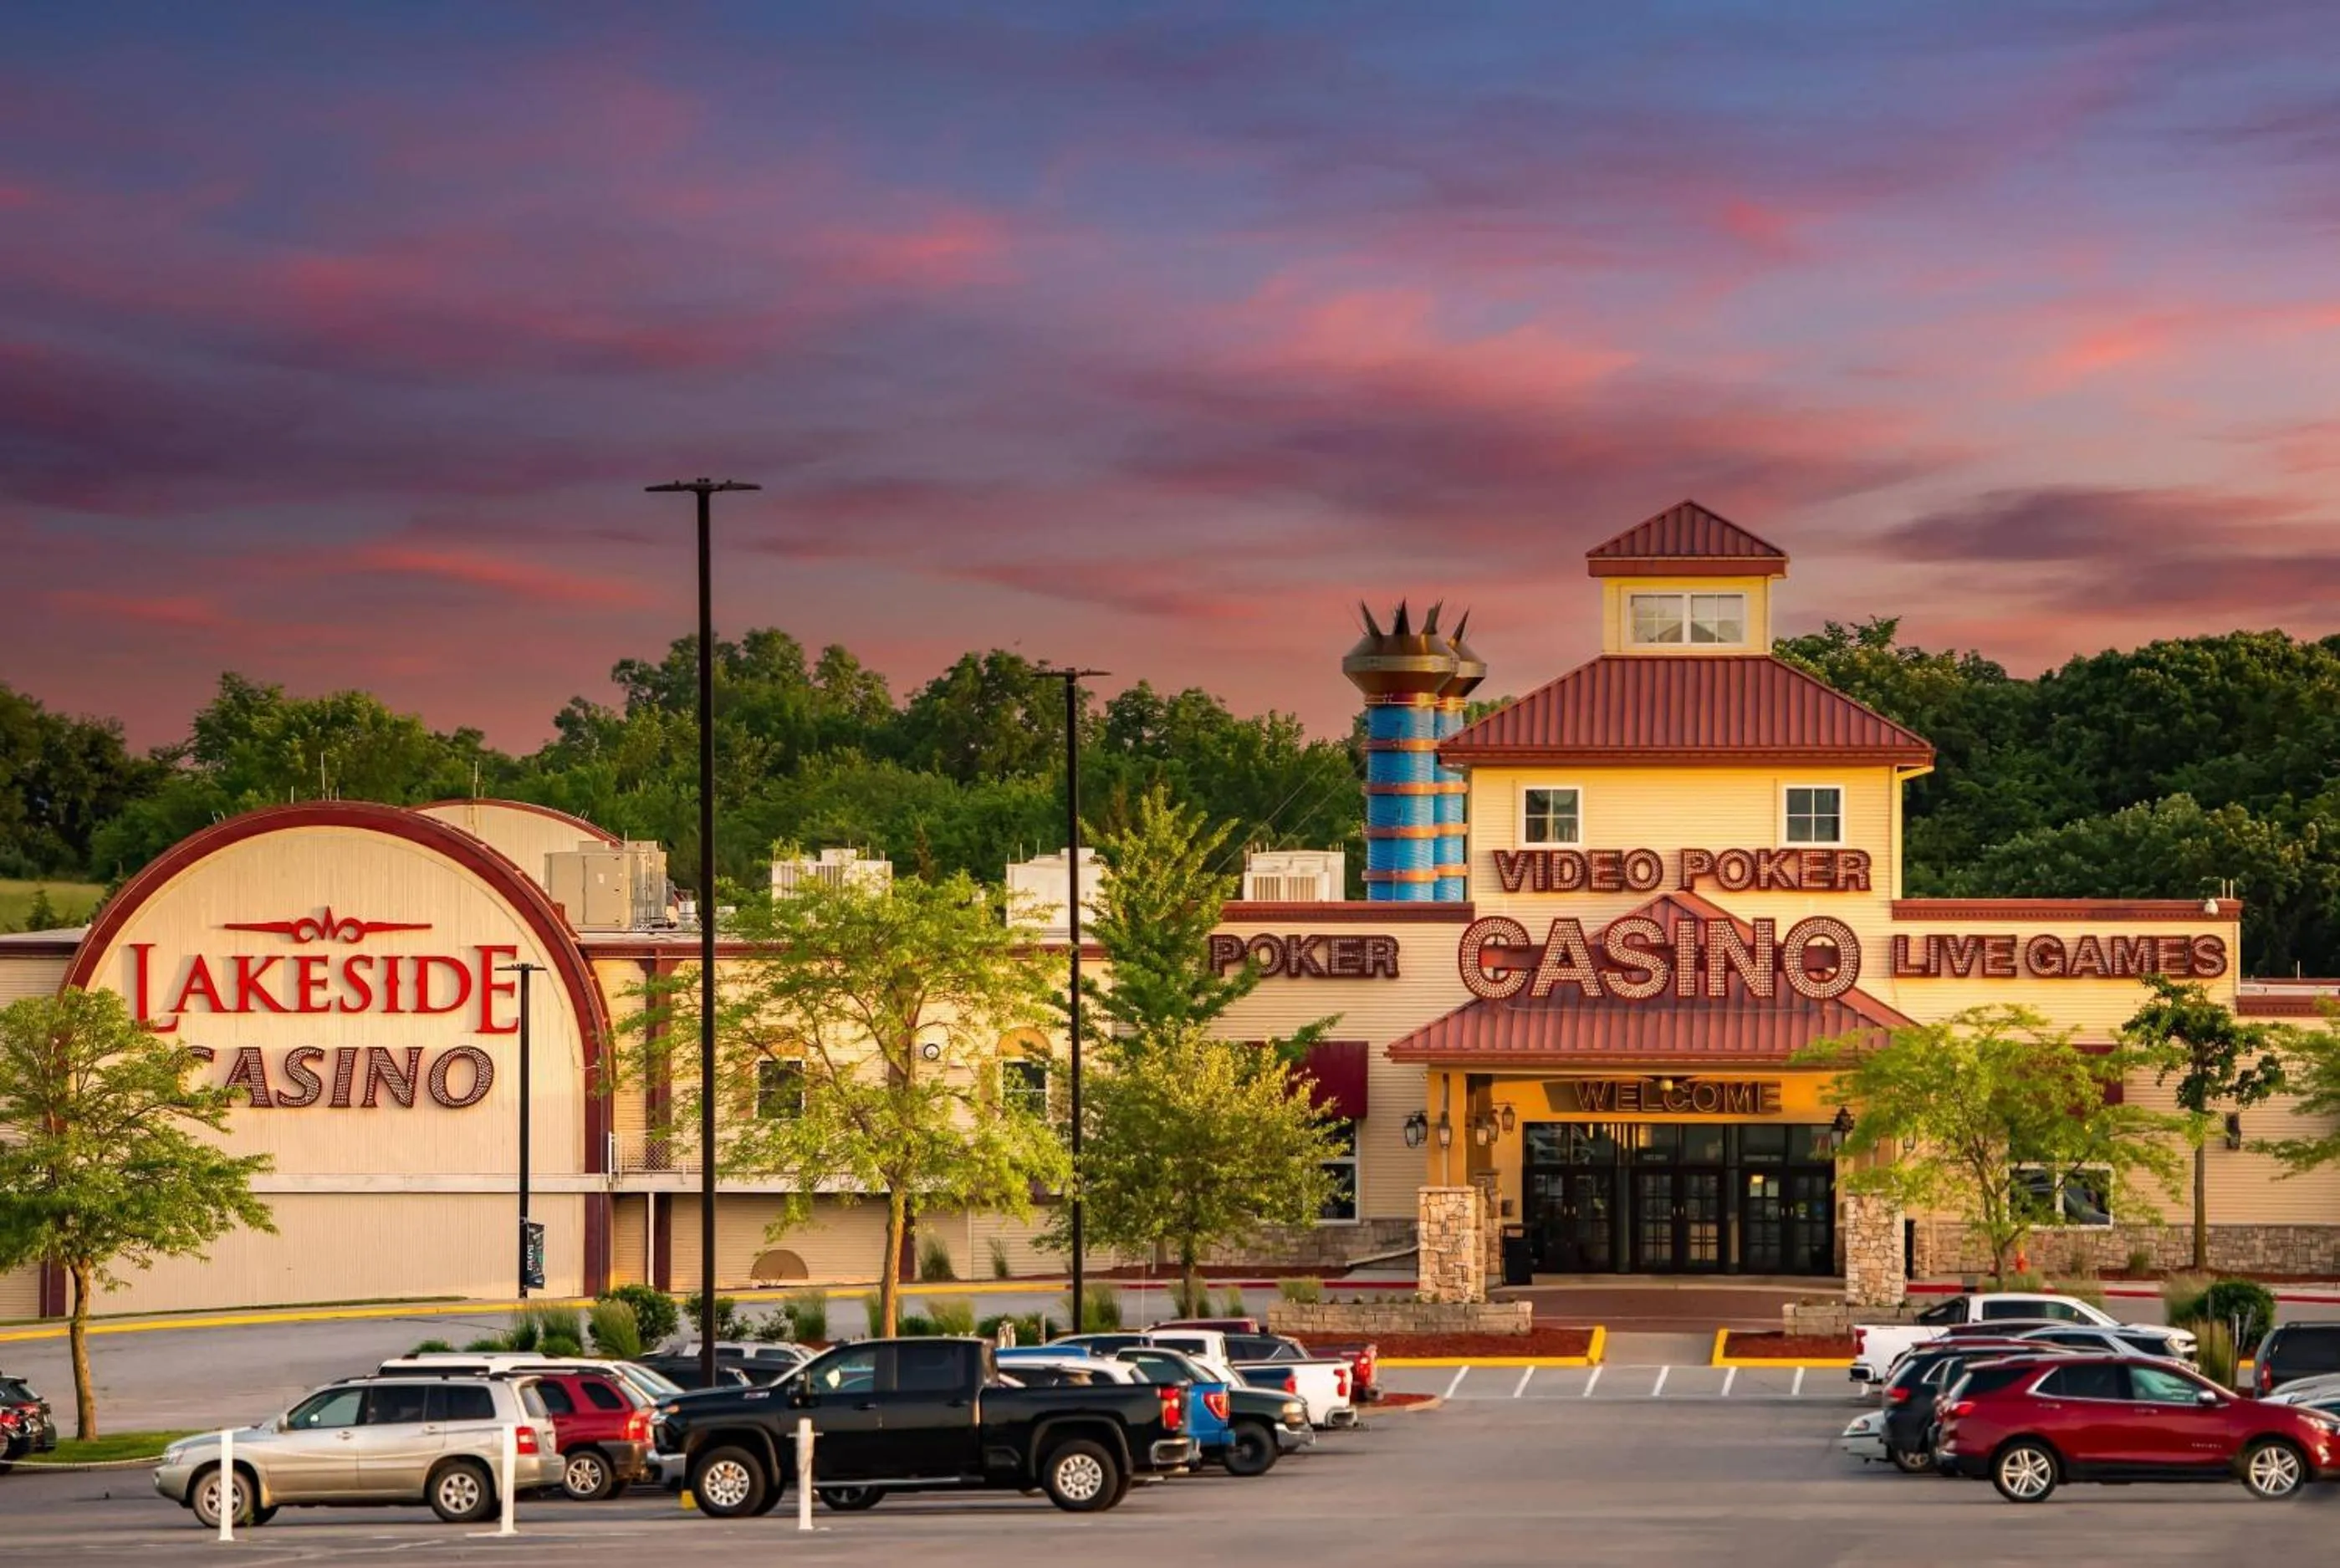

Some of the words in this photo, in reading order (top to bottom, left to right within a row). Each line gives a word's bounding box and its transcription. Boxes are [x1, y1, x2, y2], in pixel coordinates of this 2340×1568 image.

[1493, 848, 1663, 892] VIDEO
[1679, 848, 1873, 891] POKER
[1208, 932, 1400, 978] POKER
[1458, 915, 1862, 1000] CASINO
[1893, 934, 2017, 978] LIVE
[2026, 934, 2228, 978] GAMES
[129, 943, 519, 1034] LAKESIDE
[1574, 1080, 1782, 1113] WELCOME
